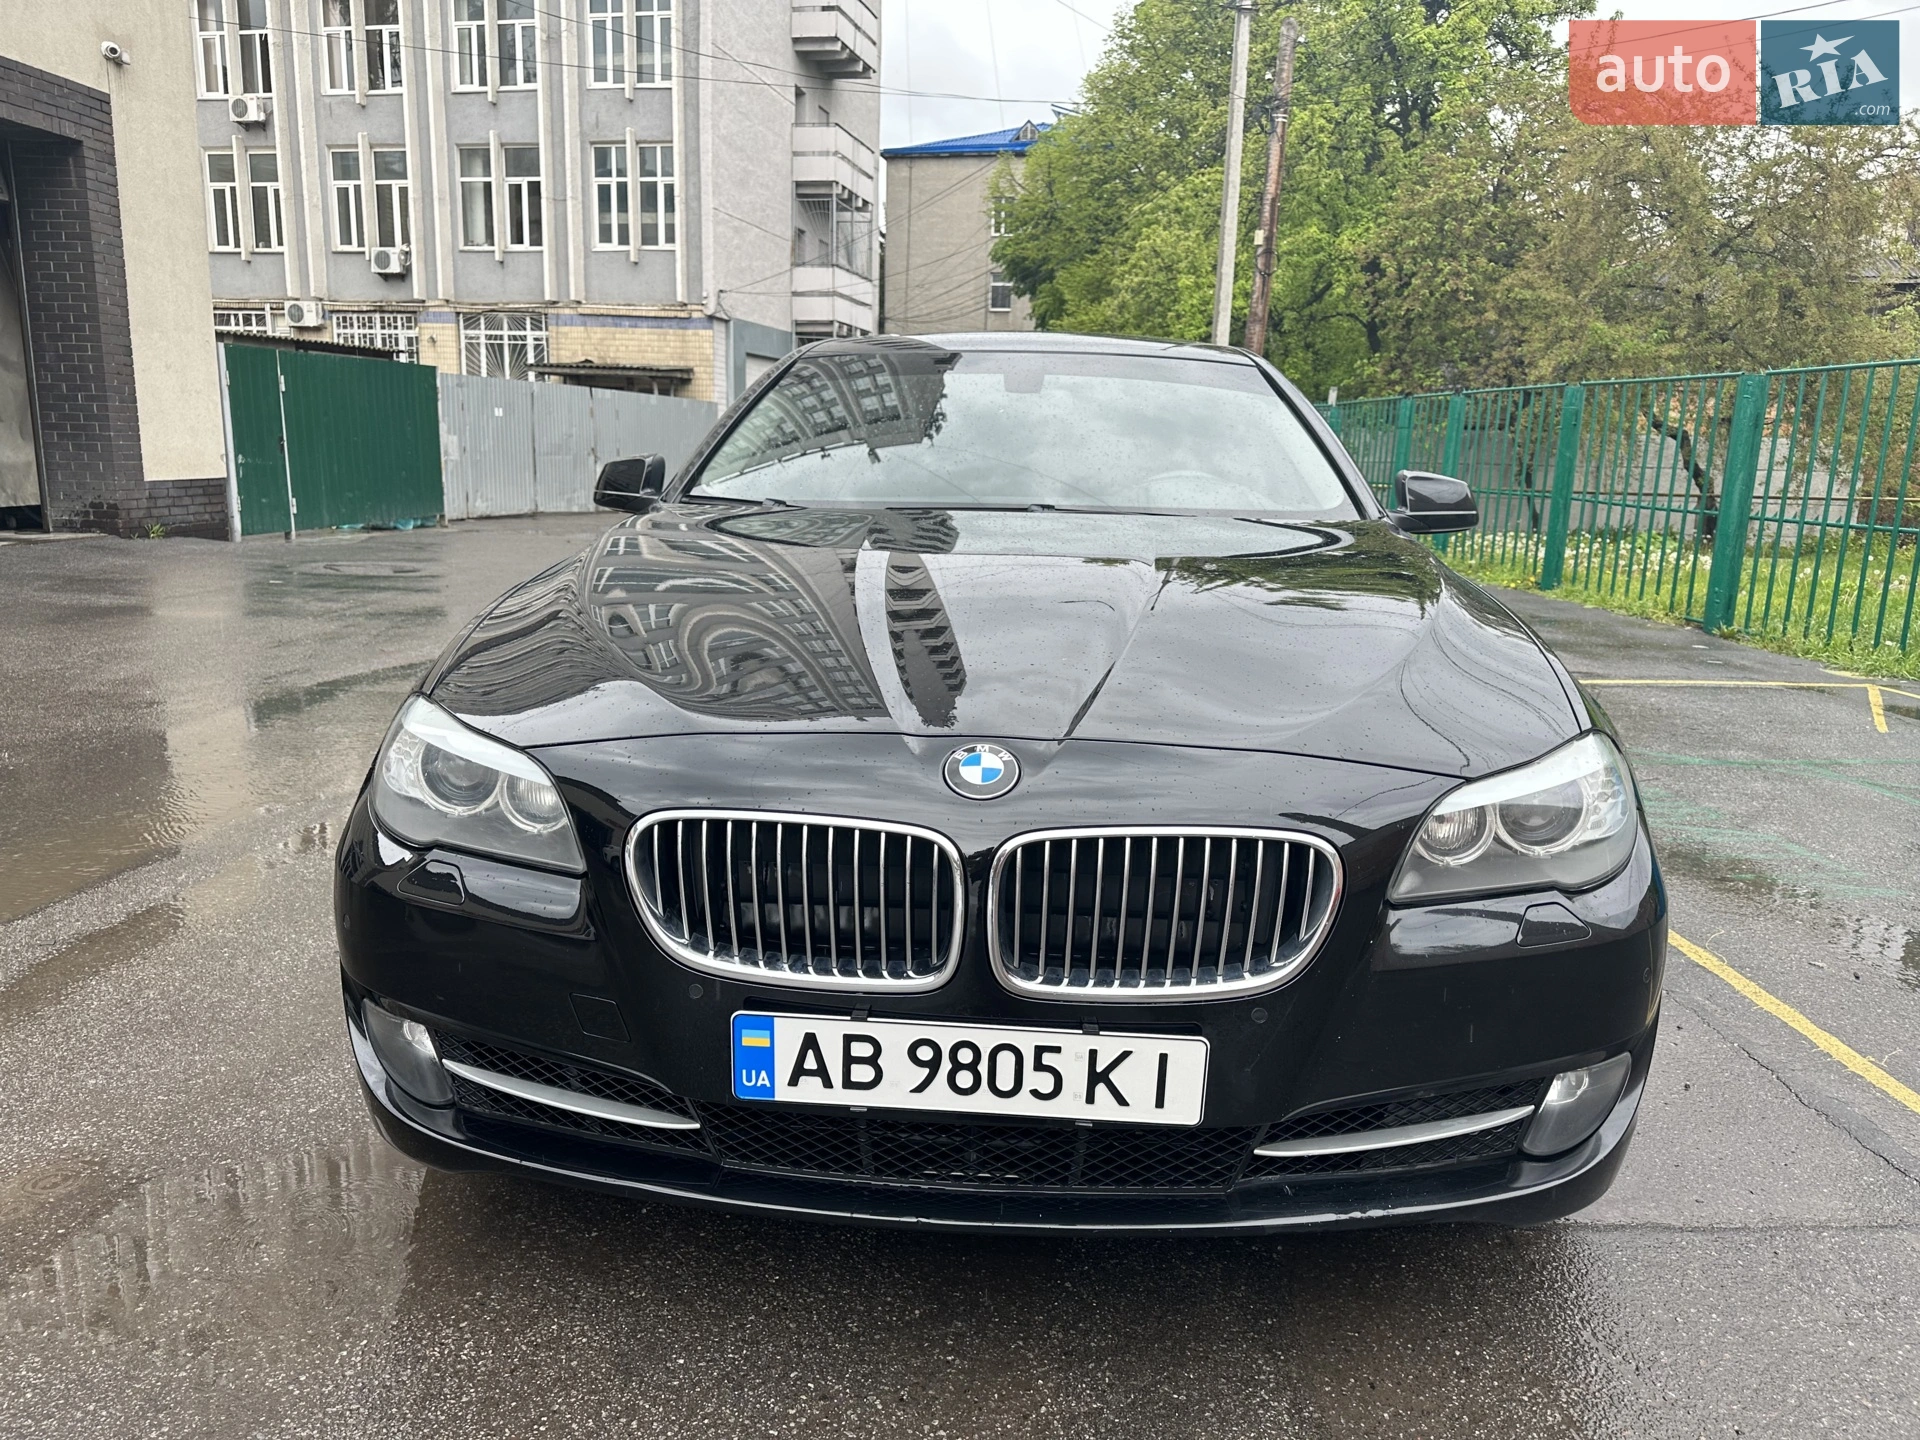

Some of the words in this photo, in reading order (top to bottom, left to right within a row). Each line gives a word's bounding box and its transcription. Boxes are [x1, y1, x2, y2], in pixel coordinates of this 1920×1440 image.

[953, 745, 1013, 761] BMW
[787, 1032, 883, 1091] AB
[907, 1037, 1063, 1101] 9805
[742, 1069, 771, 1087] UA
